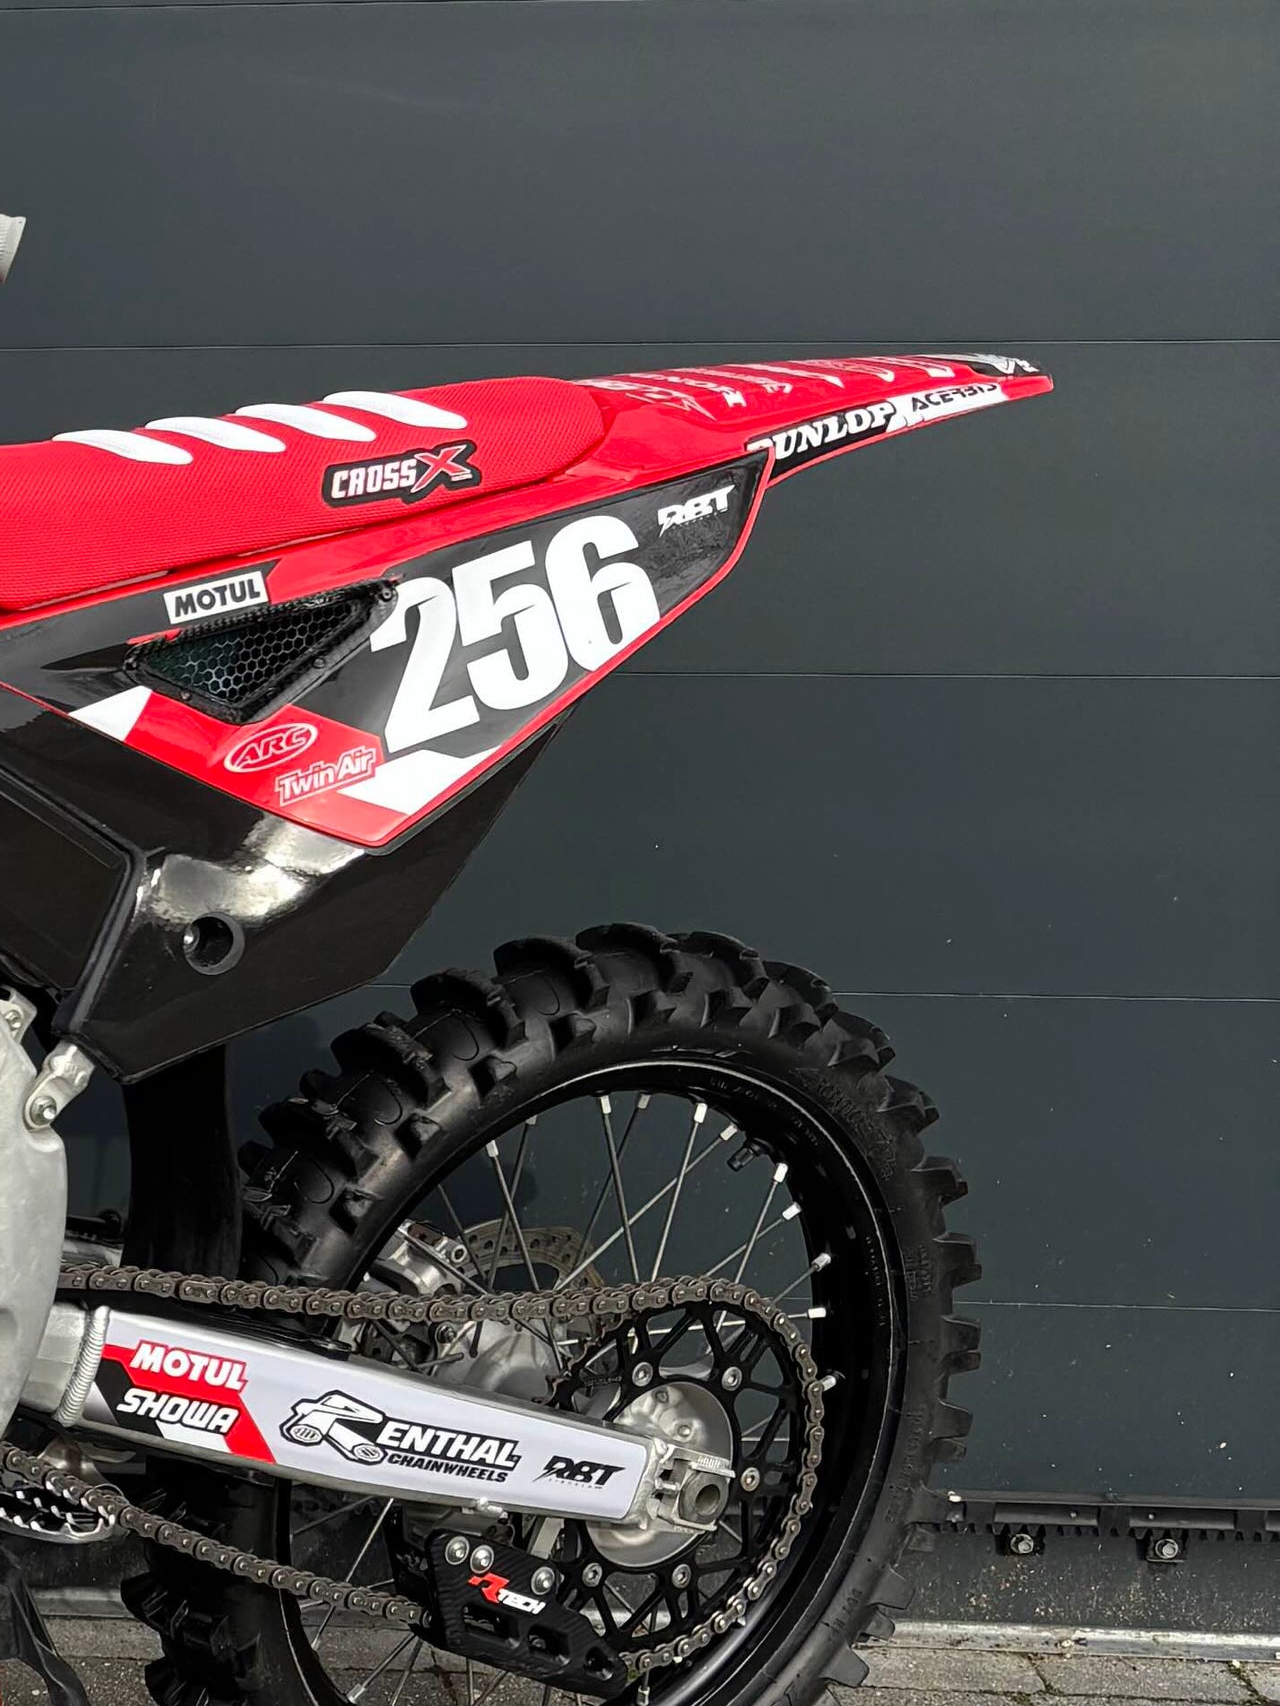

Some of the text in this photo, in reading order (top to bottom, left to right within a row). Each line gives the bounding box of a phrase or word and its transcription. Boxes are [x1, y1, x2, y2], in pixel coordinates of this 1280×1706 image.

[173, 579, 262, 618] MOTUL
[370, 514, 661, 754] 256
[233, 723, 310, 770] ARC
[278, 749, 374, 801] Twin Air
[129, 1341, 248, 1390] MOTUL
[116, 1388, 240, 1435] SHOWA
[279, 1389, 521, 1472] RENTHAL
[386, 1452, 509, 1484] CHAINWHEELS
